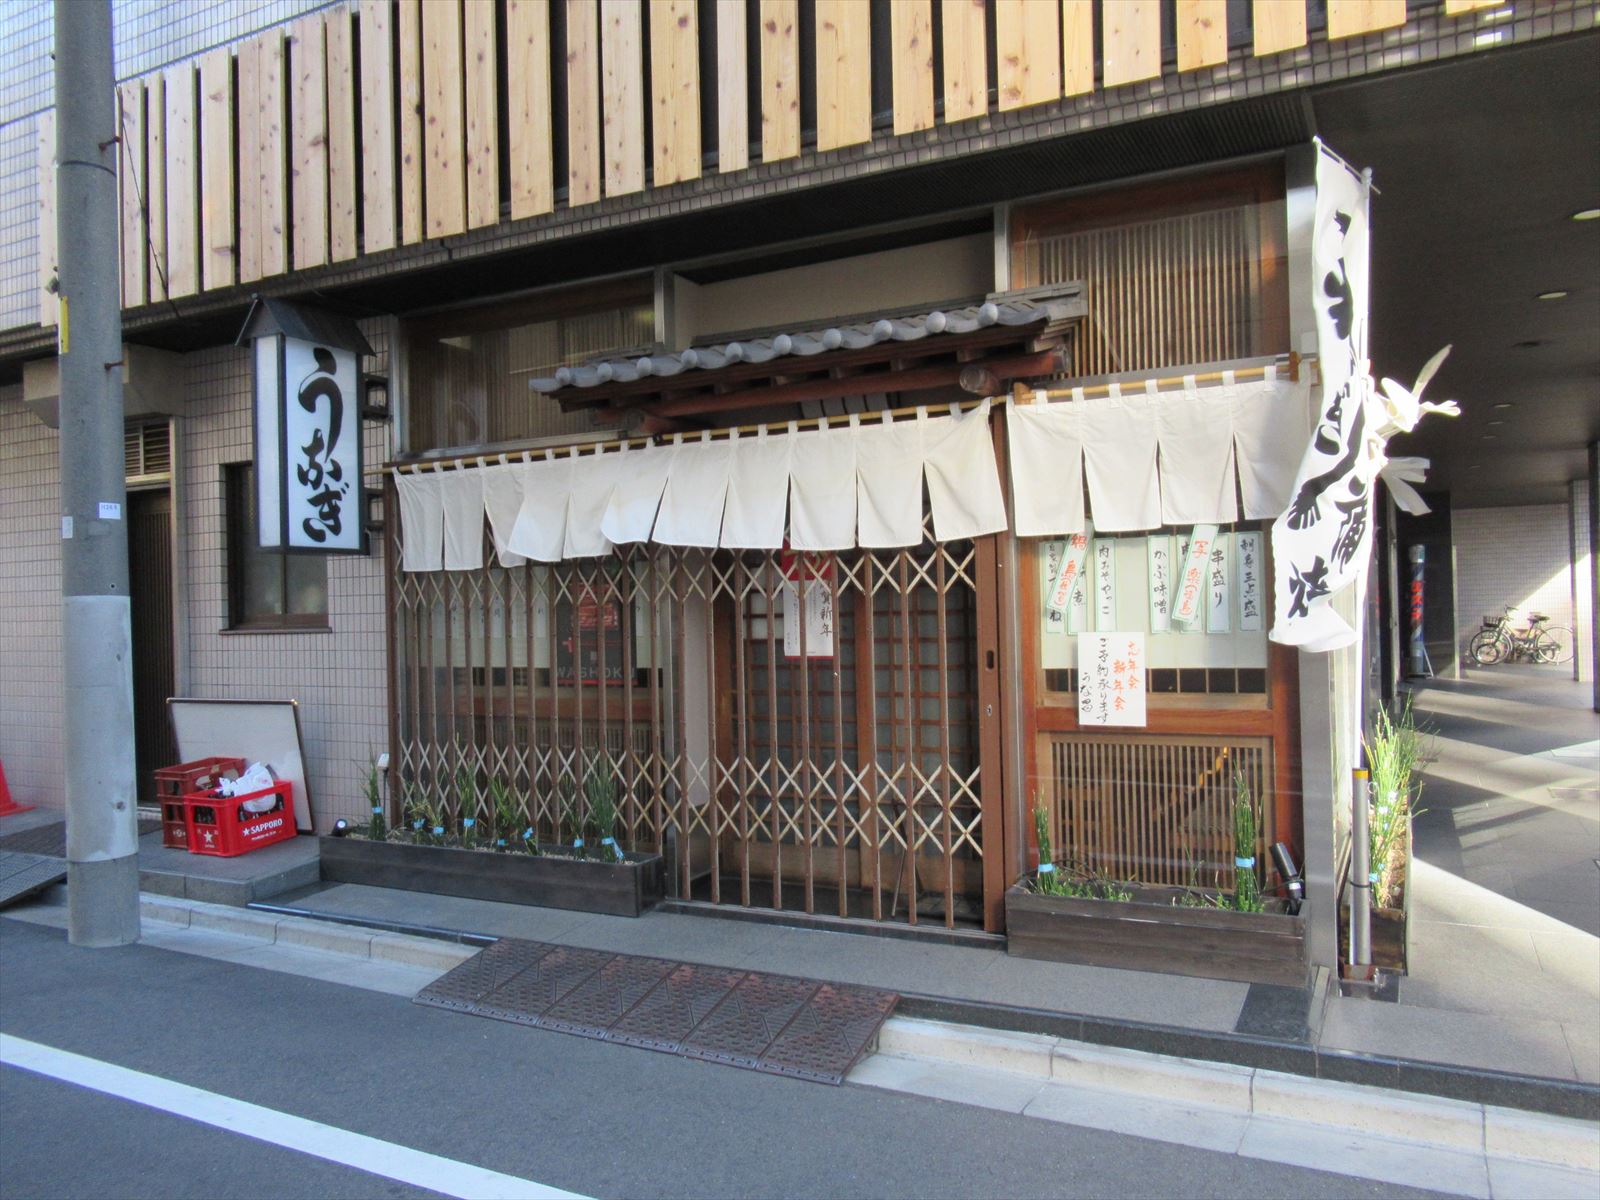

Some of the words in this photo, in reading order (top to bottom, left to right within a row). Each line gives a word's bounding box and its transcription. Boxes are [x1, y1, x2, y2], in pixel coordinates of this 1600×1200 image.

[297, 347, 350, 543] うなぎ
[1210, 549, 1226, 608] 串盛り
[1112, 658, 1126, 711] 新年会
[250, 817, 284, 836] SAPPORO
